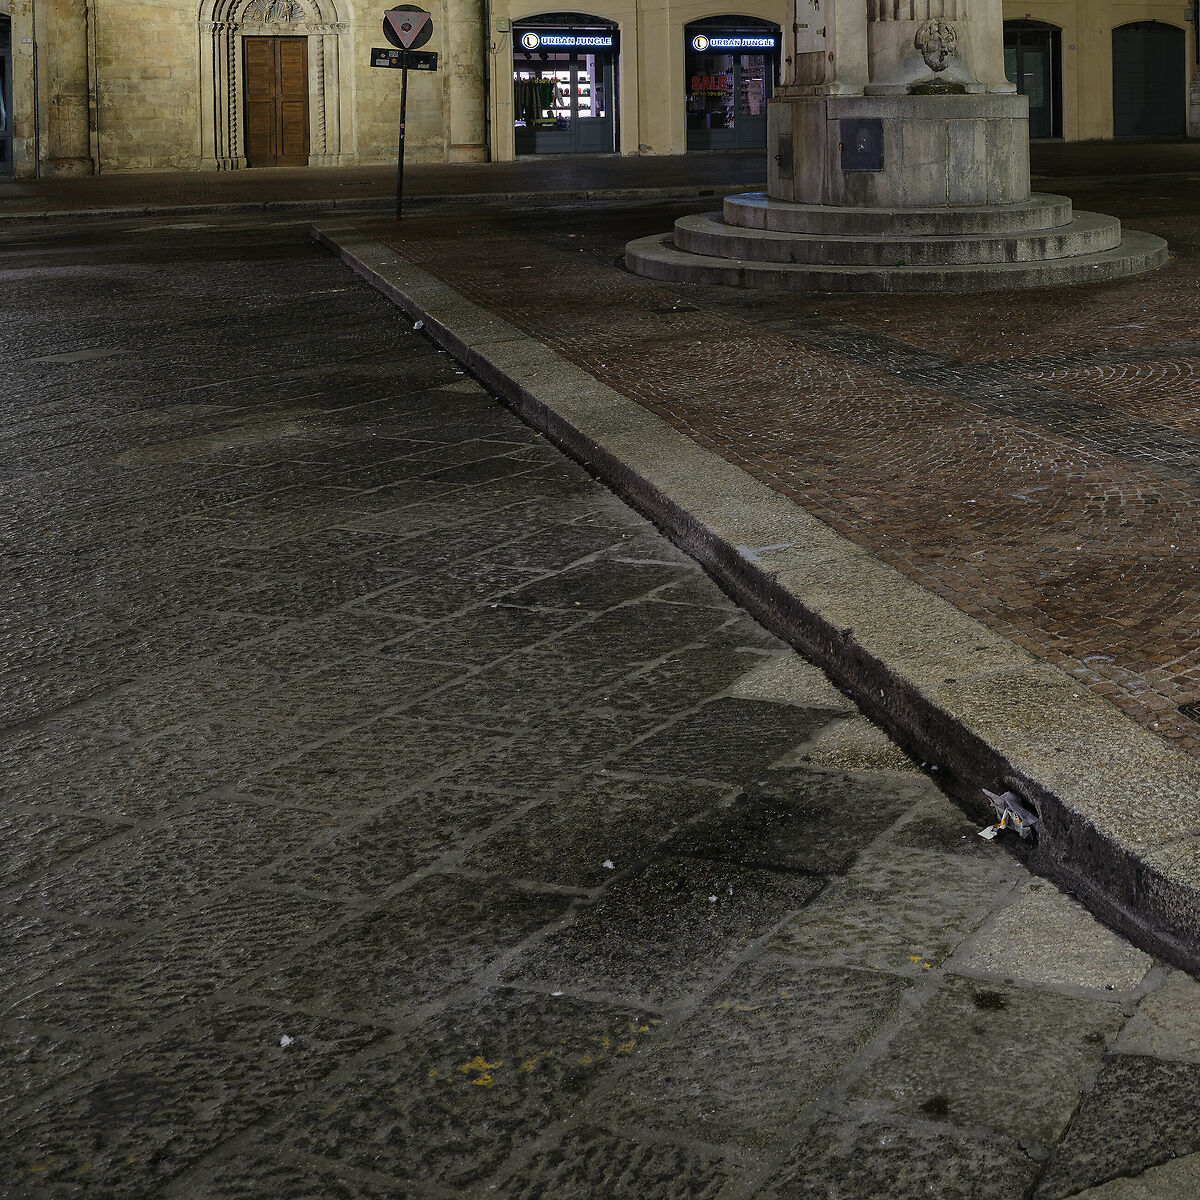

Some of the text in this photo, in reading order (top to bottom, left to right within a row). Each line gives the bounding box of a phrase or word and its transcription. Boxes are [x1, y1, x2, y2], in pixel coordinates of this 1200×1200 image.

[541, 37, 612, 46] URBAN JUNGLE
[710, 38, 775, 47] URBAN JUNGLE
[692, 75, 727, 90] SALE
